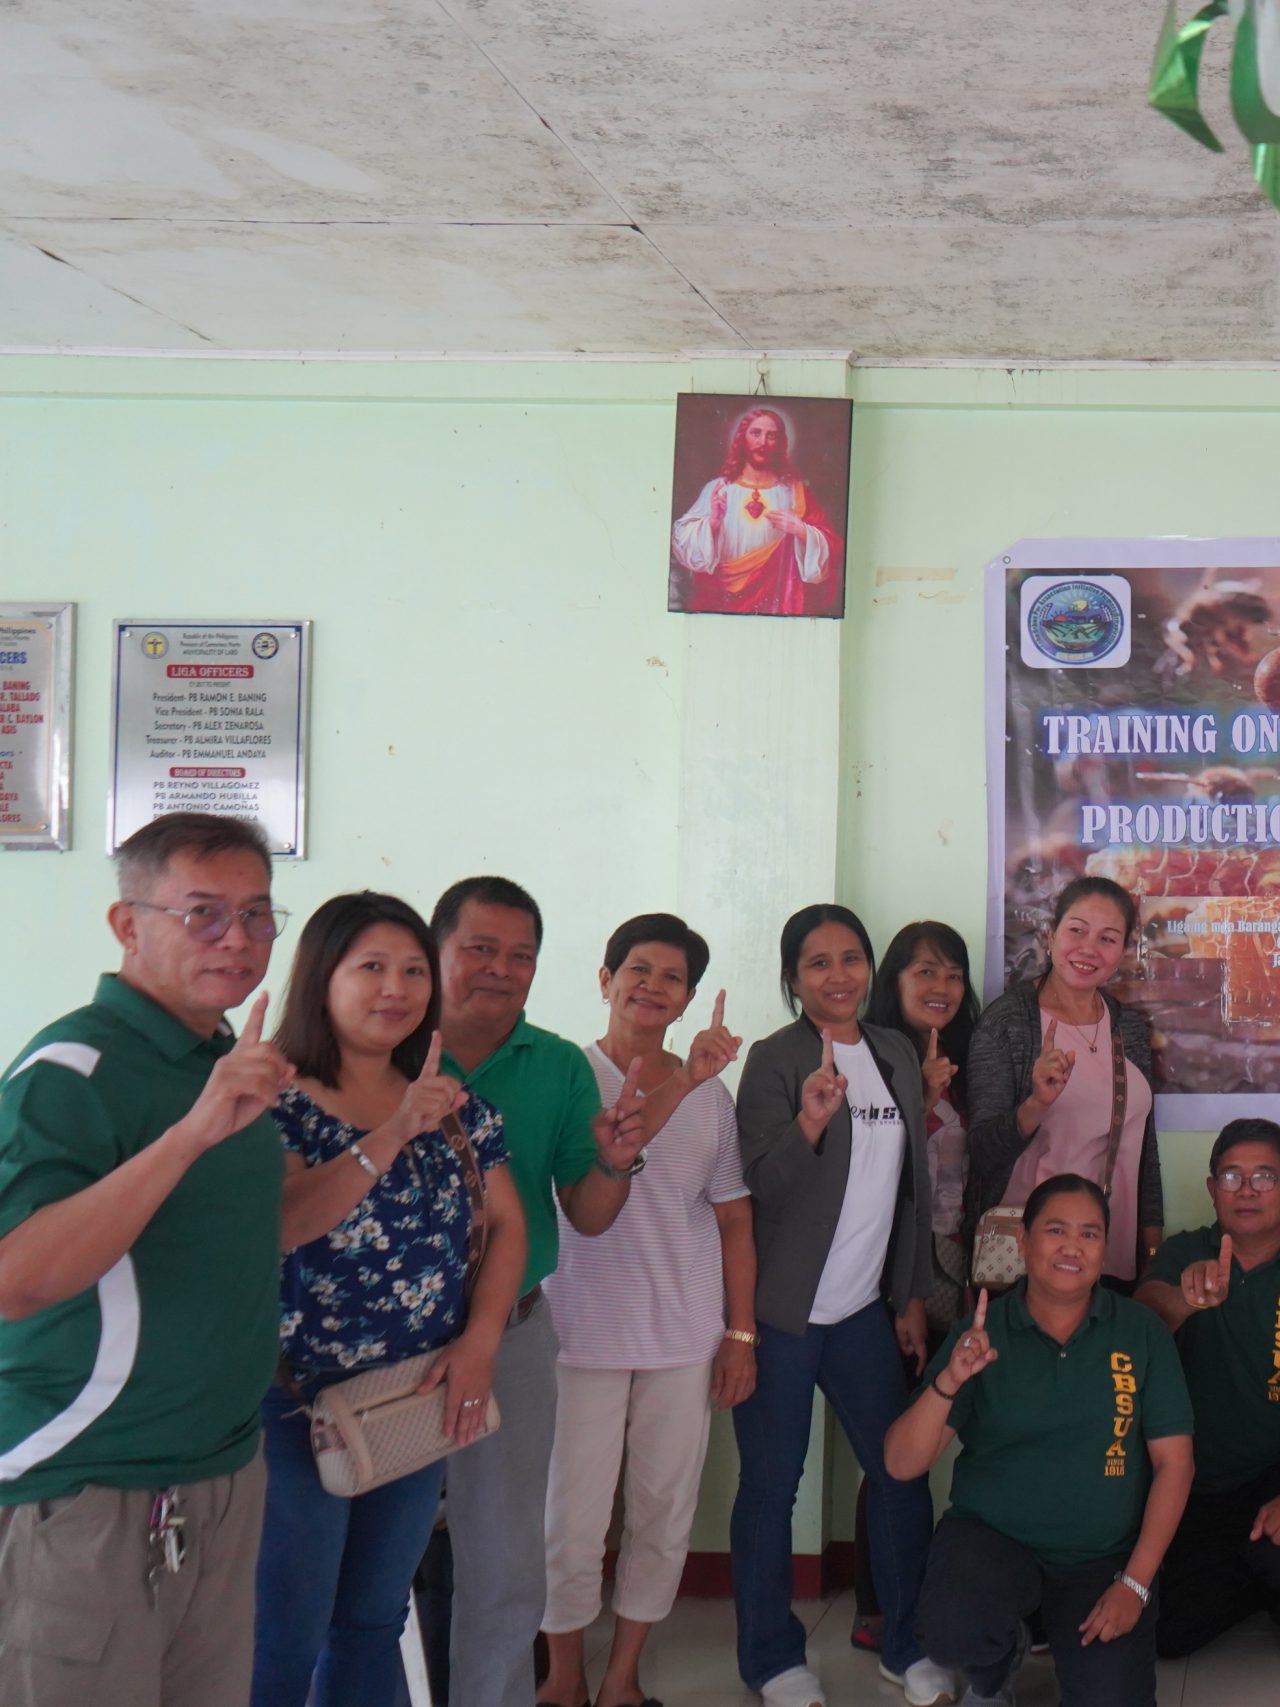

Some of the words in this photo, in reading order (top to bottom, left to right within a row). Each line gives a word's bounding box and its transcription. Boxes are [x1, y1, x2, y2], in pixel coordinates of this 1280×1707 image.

[171, 666, 197, 677] LIGA
[199, 666, 249, 677] OFFICERS
[200, 692, 227, 702] RAMON
[245, 706, 264, 716] RALA
[204, 721, 222, 730] ALEX
[1043, 713, 1217, 755] TRAINING
[224, 735, 272, 744] VILLAFLORES
[193, 750, 235, 758] EMMANUEL
[1105, 1352, 1137, 1457] CBSUA
